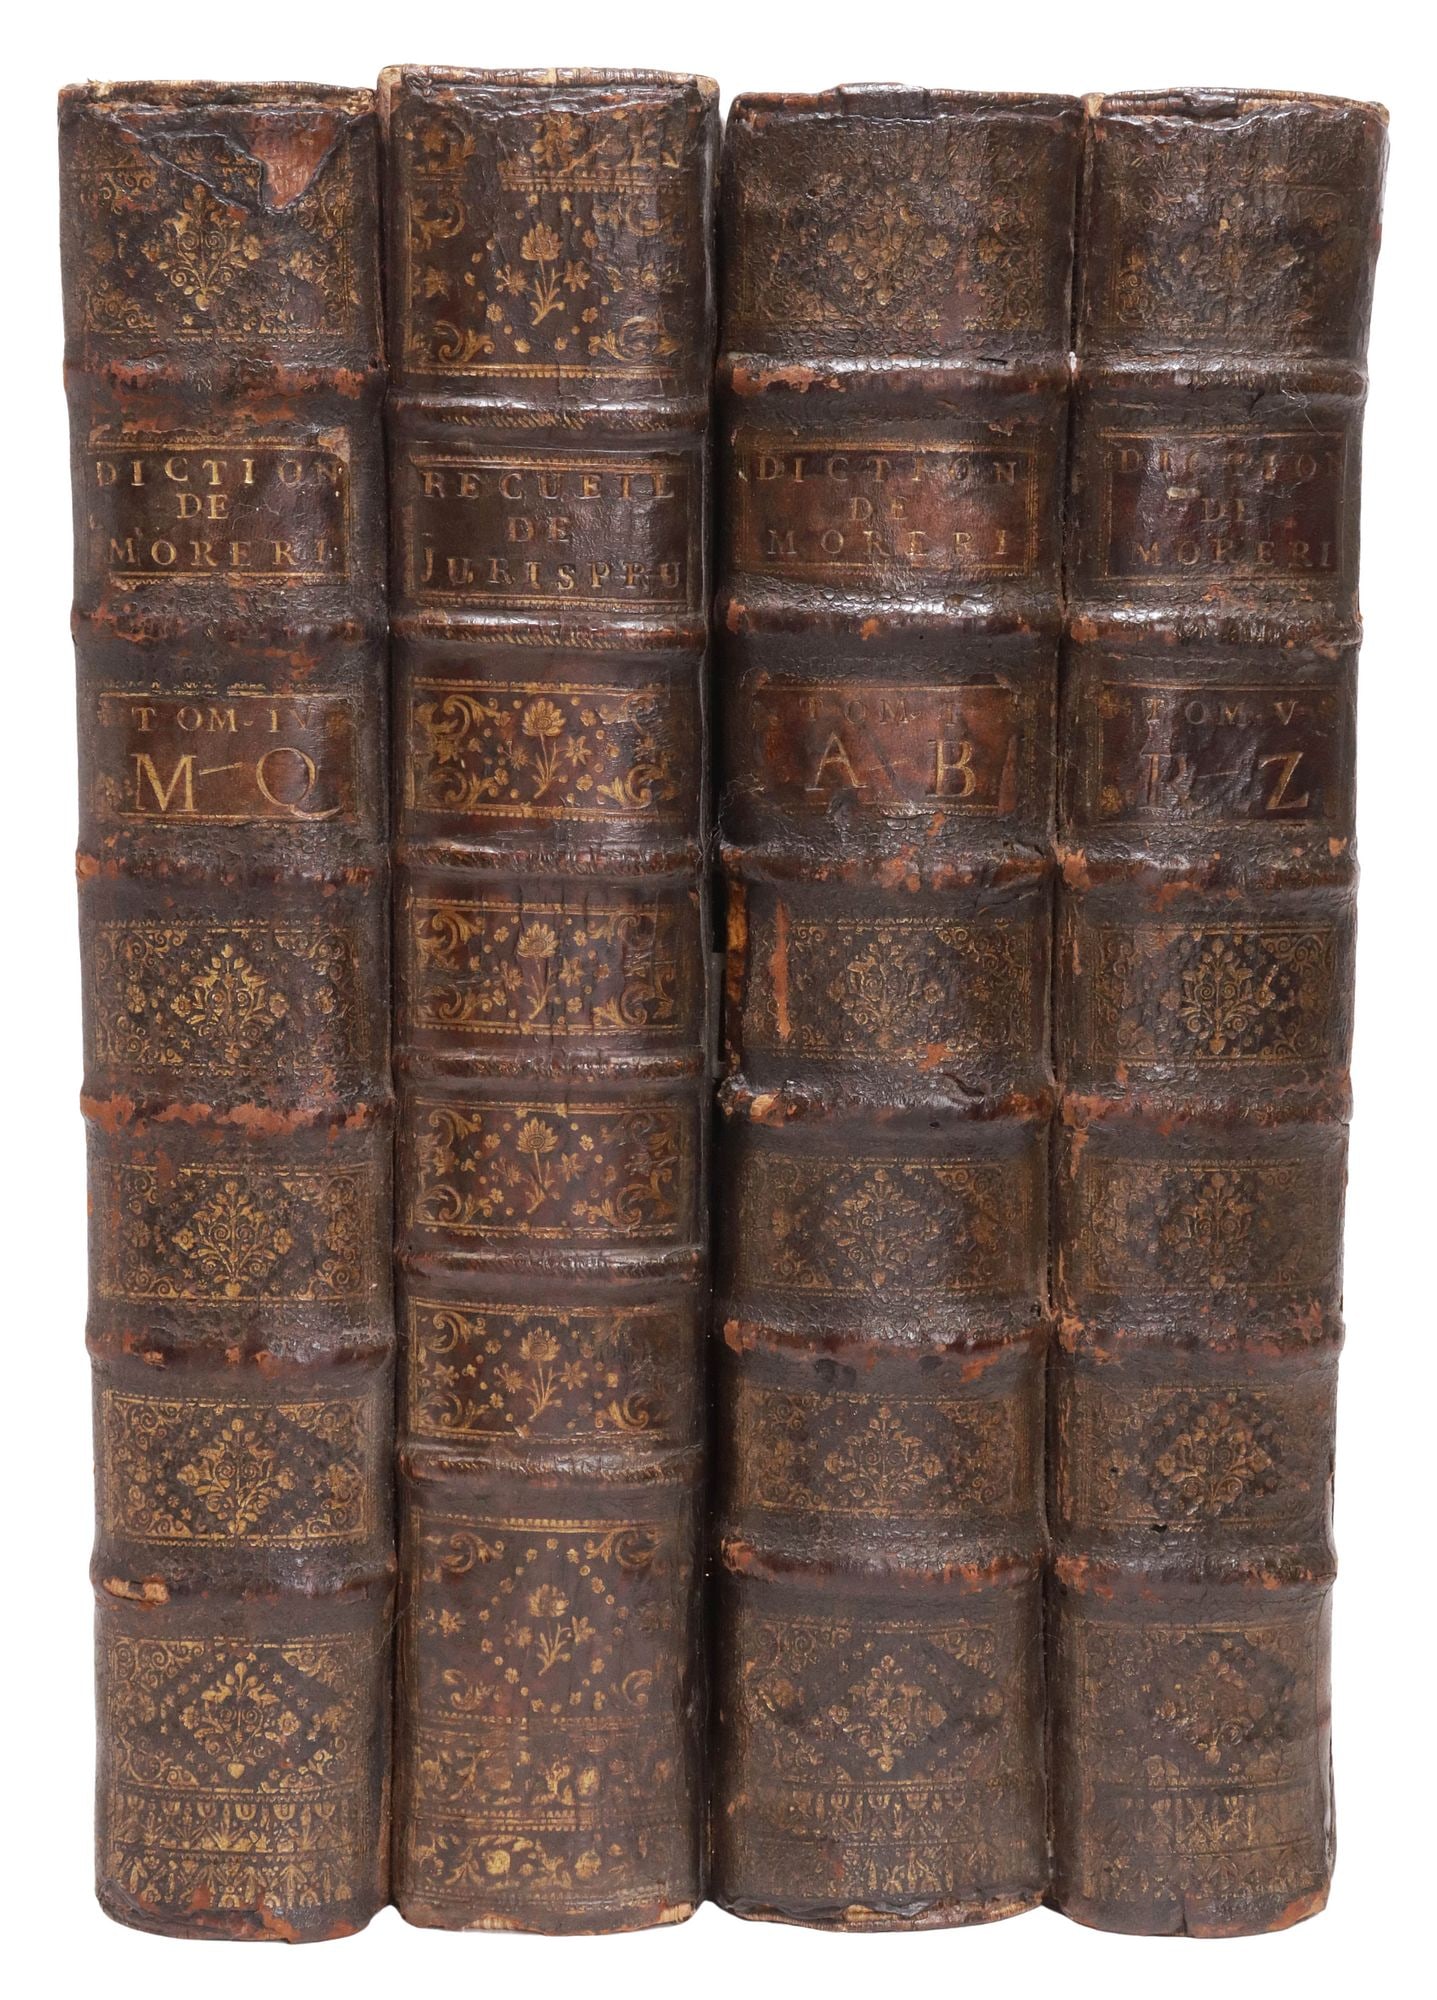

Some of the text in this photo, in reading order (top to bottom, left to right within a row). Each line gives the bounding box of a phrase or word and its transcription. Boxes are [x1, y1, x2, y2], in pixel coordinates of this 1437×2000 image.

[756, 455, 1017, 484] DICTION
[422, 472, 675, 500] RECUEIL
[176, 493, 230, 520] DE
[851, 497, 909, 520] DE
[507, 516, 571, 542] DE
[108, 537, 328, 567] MORERI
[767, 530, 1008, 556] MORERI
[419, 548, 681, 591] JURISPRU
